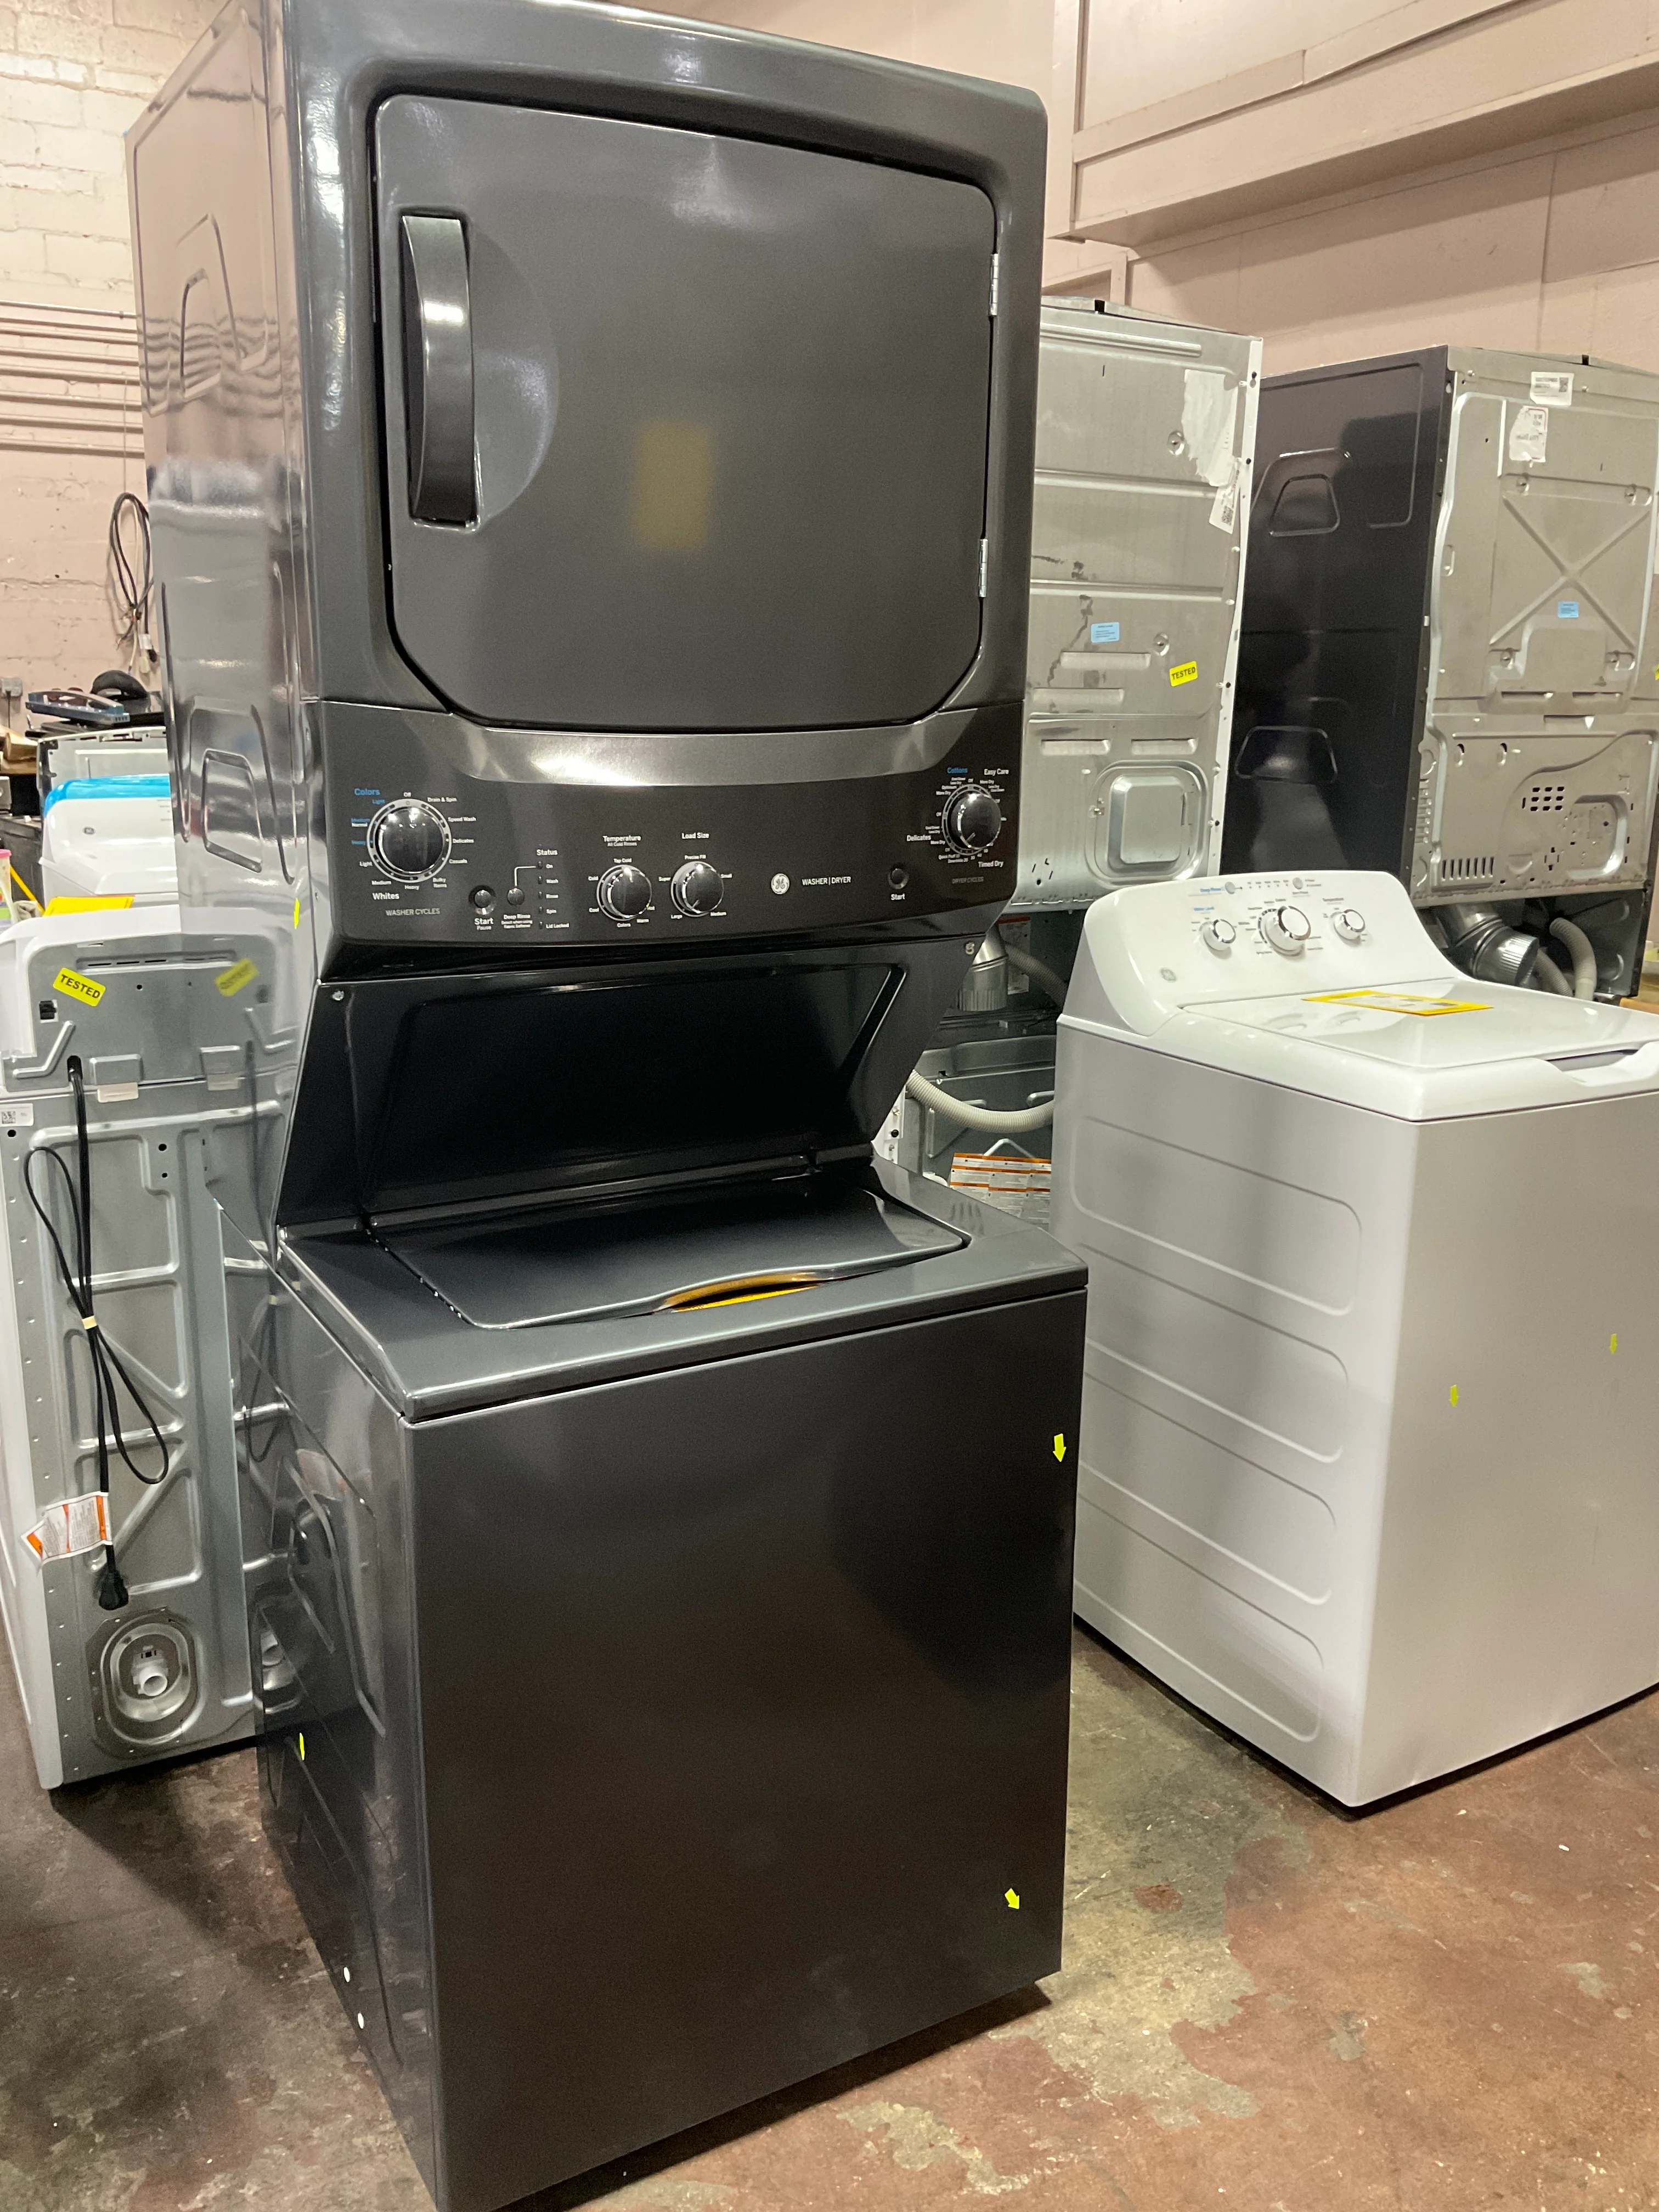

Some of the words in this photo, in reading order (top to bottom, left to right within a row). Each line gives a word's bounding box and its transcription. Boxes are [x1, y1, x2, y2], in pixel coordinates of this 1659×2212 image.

[1172, 667, 1196, 680] TESTED
[603, 834, 641, 843] Temperature
[802, 878, 827, 886] WASHER
[474, 917, 494, 926] Start
[59, 974, 101, 999] TESTED
